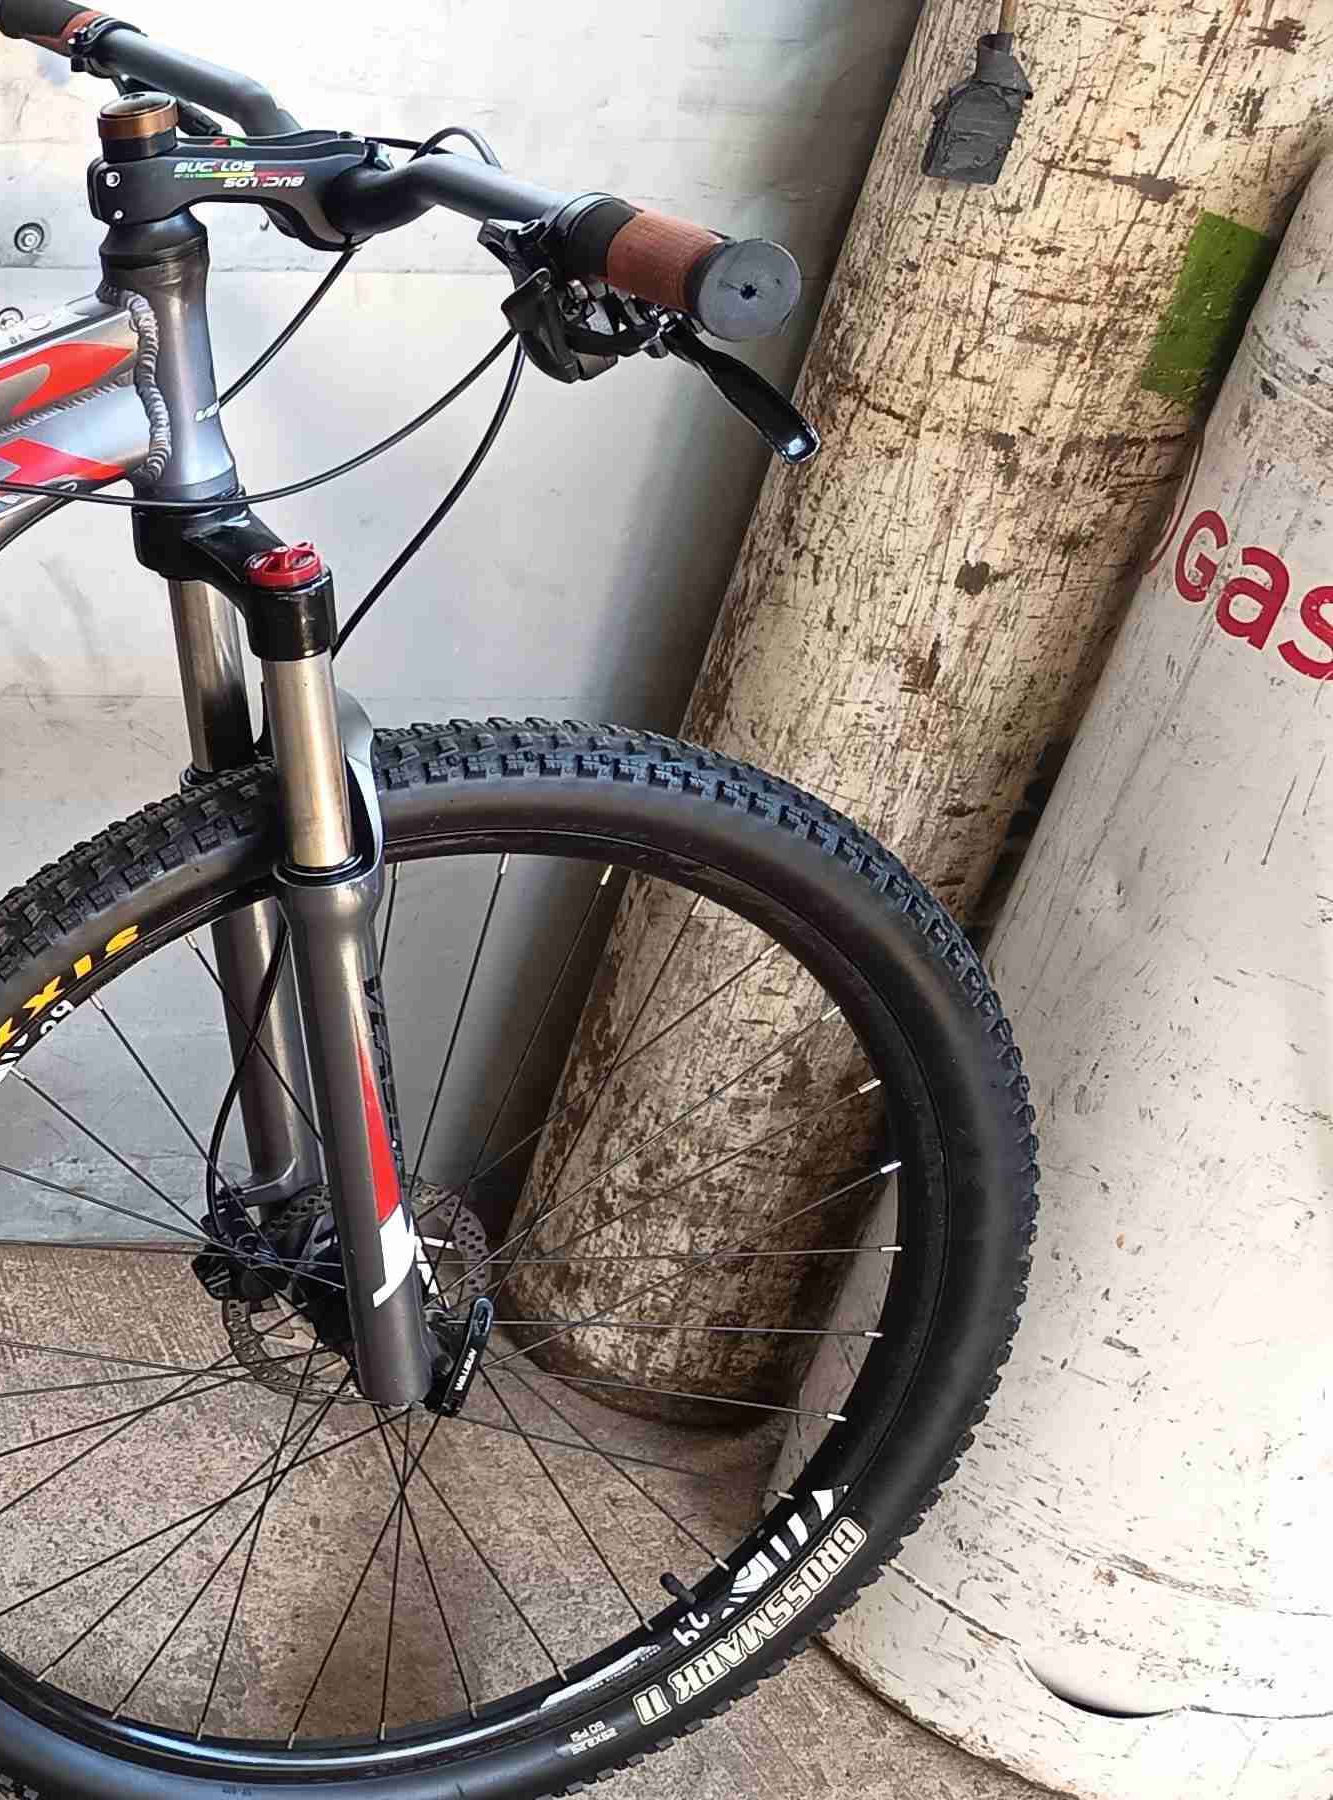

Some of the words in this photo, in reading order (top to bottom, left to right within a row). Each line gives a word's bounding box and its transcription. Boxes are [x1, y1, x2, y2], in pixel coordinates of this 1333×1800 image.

[1175, 509, 1333, 681] Gas
[668, 1516, 868, 1704] CROSSMARK
[672, 1610, 711, 1648] 29
